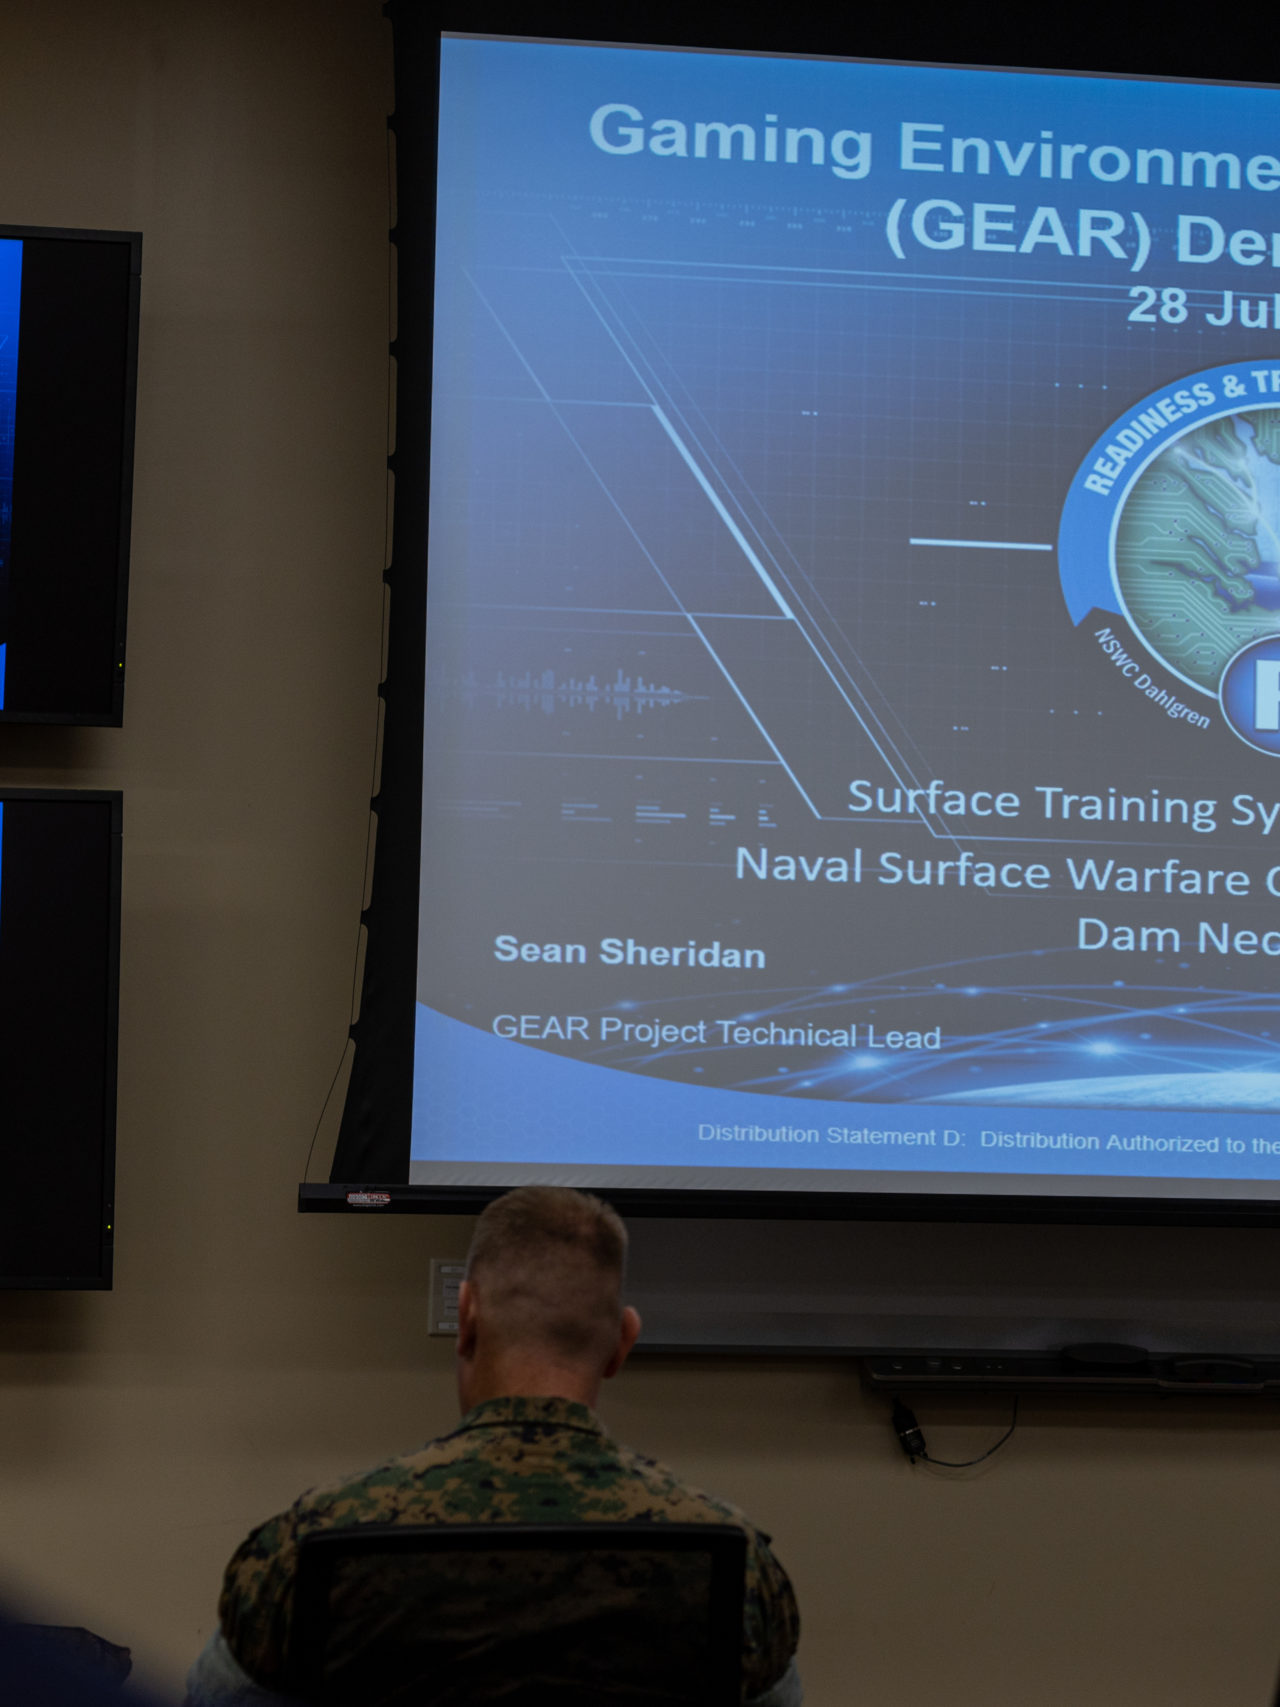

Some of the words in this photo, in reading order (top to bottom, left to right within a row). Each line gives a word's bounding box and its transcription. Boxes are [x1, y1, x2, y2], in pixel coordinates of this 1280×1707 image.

[589, 103, 873, 180] Gaming
[886, 199, 1152, 272] (GEAR)
[1127, 285, 1188, 324] 28
[1083, 382, 1216, 496] READINESS
[1222, 374, 1248, 399] &
[1094, 627, 1140, 678] NSWC
[1133, 673, 1211, 729] Dahlgren
[848, 780, 1020, 818] Surface
[1035, 786, 1217, 833] Training
[735, 846, 862, 883] Naval
[878, 851, 1051, 889] Surface
[1066, 858, 1250, 896] Warfare
[494, 935, 586, 964] Sean
[599, 938, 766, 969] Sheridan
[1078, 917, 1180, 952] Dam
[492, 1014, 589, 1041] GEAR
[600, 1017, 706, 1048] Project
[715, 1020, 857, 1048] Technical
[867, 1024, 941, 1050] Lead
[698, 1123, 819, 1144] Distribution
[826, 1127, 937, 1147] Statement
[943, 1130, 966, 1148] D:
[980, 1130, 1100, 1151] Distribution
[1106, 1134, 1219, 1154] Authorized
[1225, 1138, 1244, 1155] to
